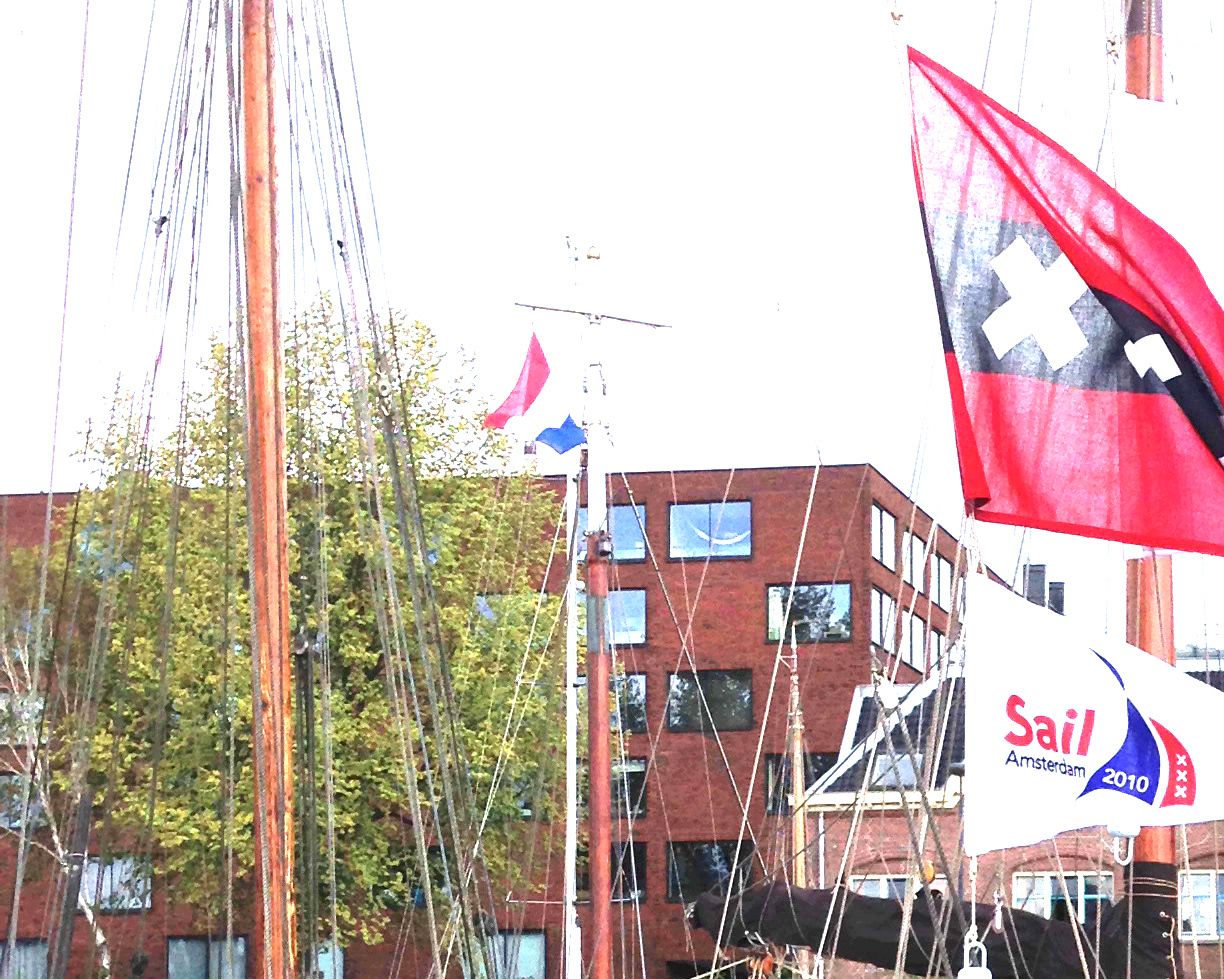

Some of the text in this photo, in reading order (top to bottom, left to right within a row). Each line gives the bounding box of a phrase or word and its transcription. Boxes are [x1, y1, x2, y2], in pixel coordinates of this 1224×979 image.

[1004, 694, 1095, 756] Sail
[1005, 750, 1086, 778] Amsterdam
[1101, 768, 1150, 793] 2010
